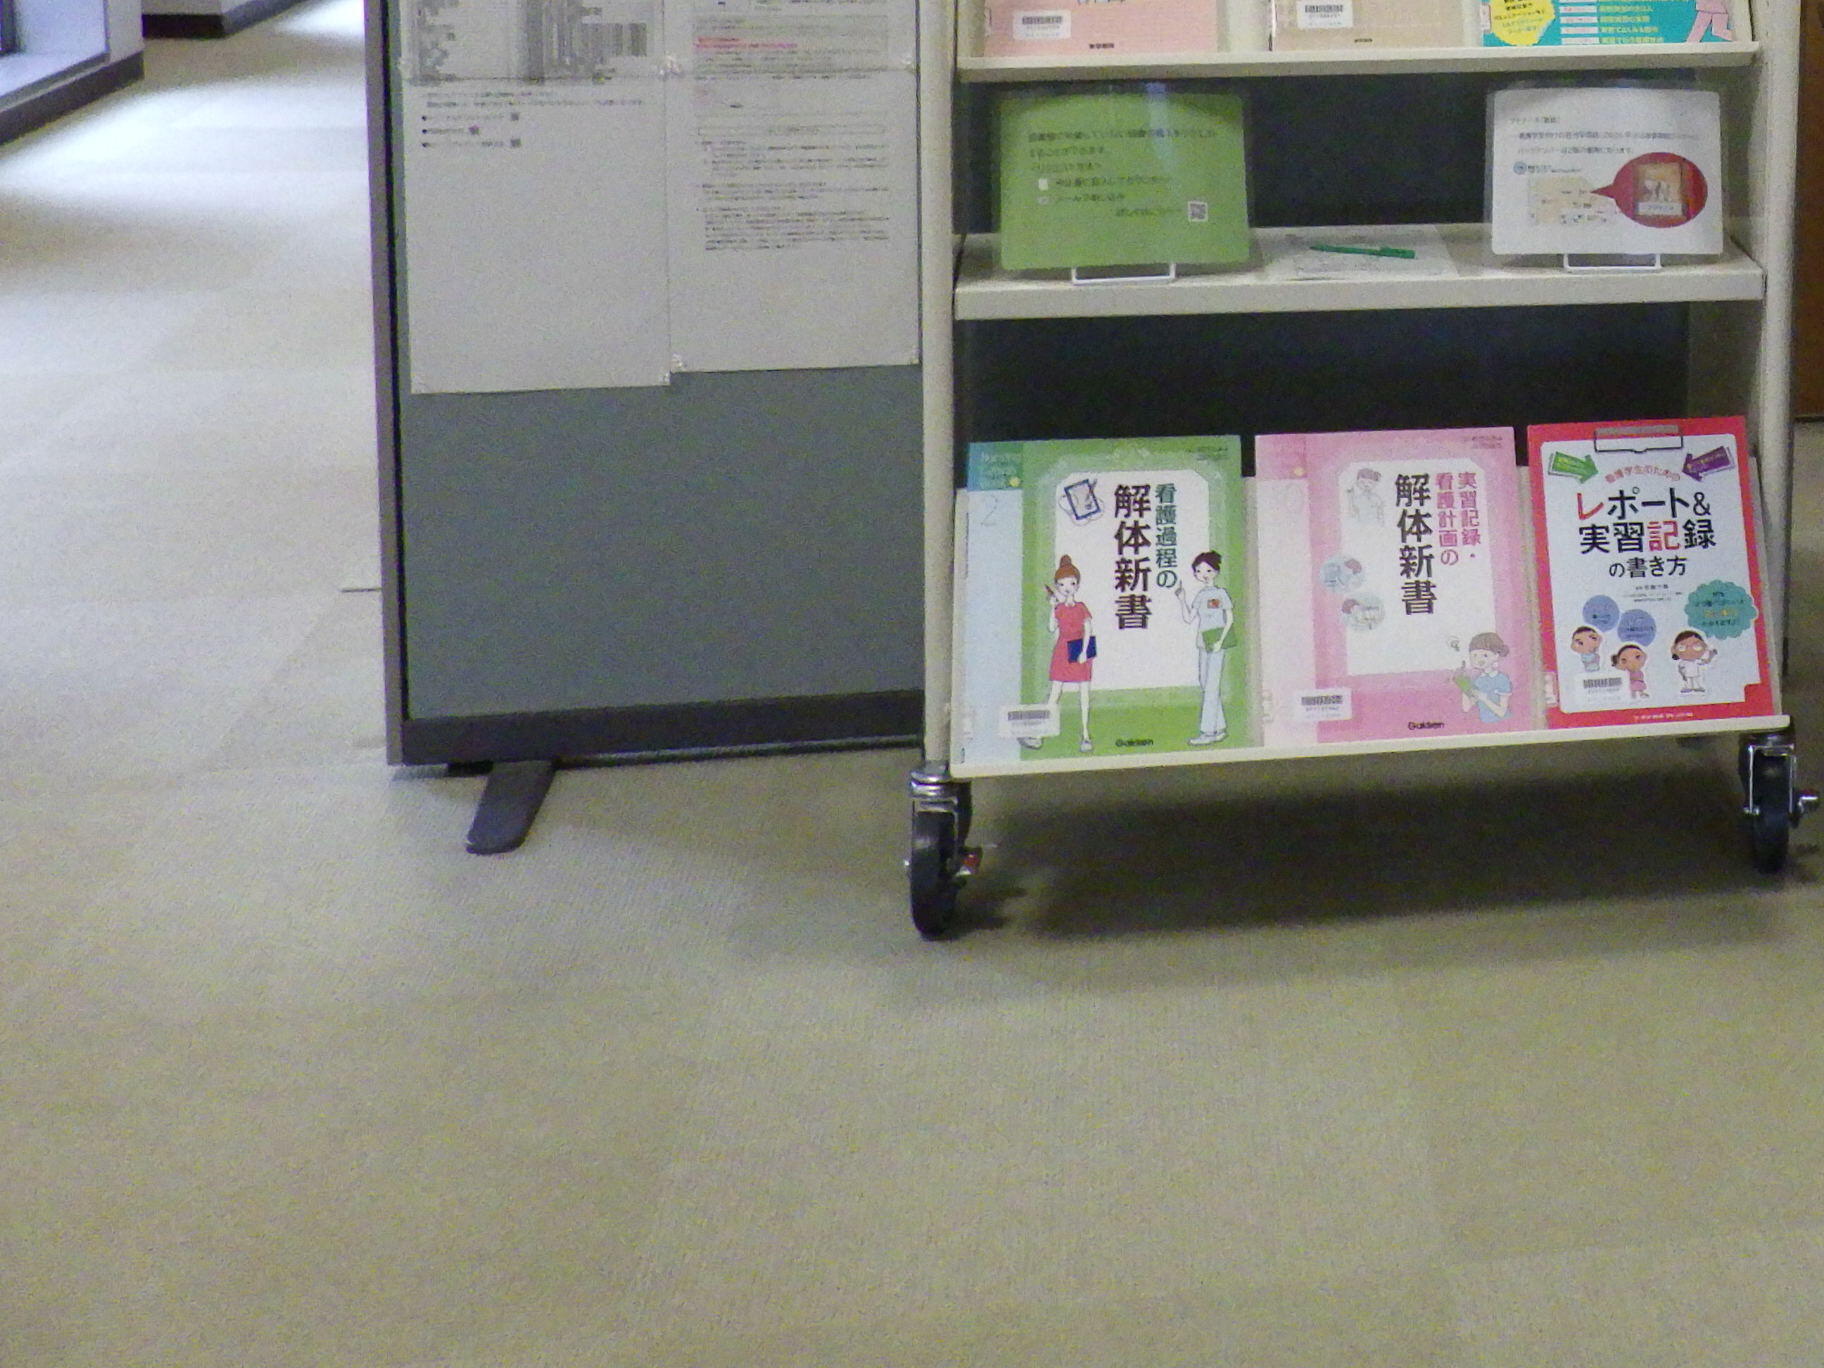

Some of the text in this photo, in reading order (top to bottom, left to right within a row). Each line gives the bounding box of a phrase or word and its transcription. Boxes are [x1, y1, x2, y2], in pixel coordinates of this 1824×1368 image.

[1155, 483, 1178, 589] 看護過程の
[1394, 473, 1437, 616] 解体新書
[1436, 473, 1459, 567] 看護計画の
[1576, 486, 1712, 521] レポート&
[1578, 519, 1717, 554] 実習記録
[1114, 484, 1152, 630] 解体新書
[1608, 555, 1687, 578] の書き方
